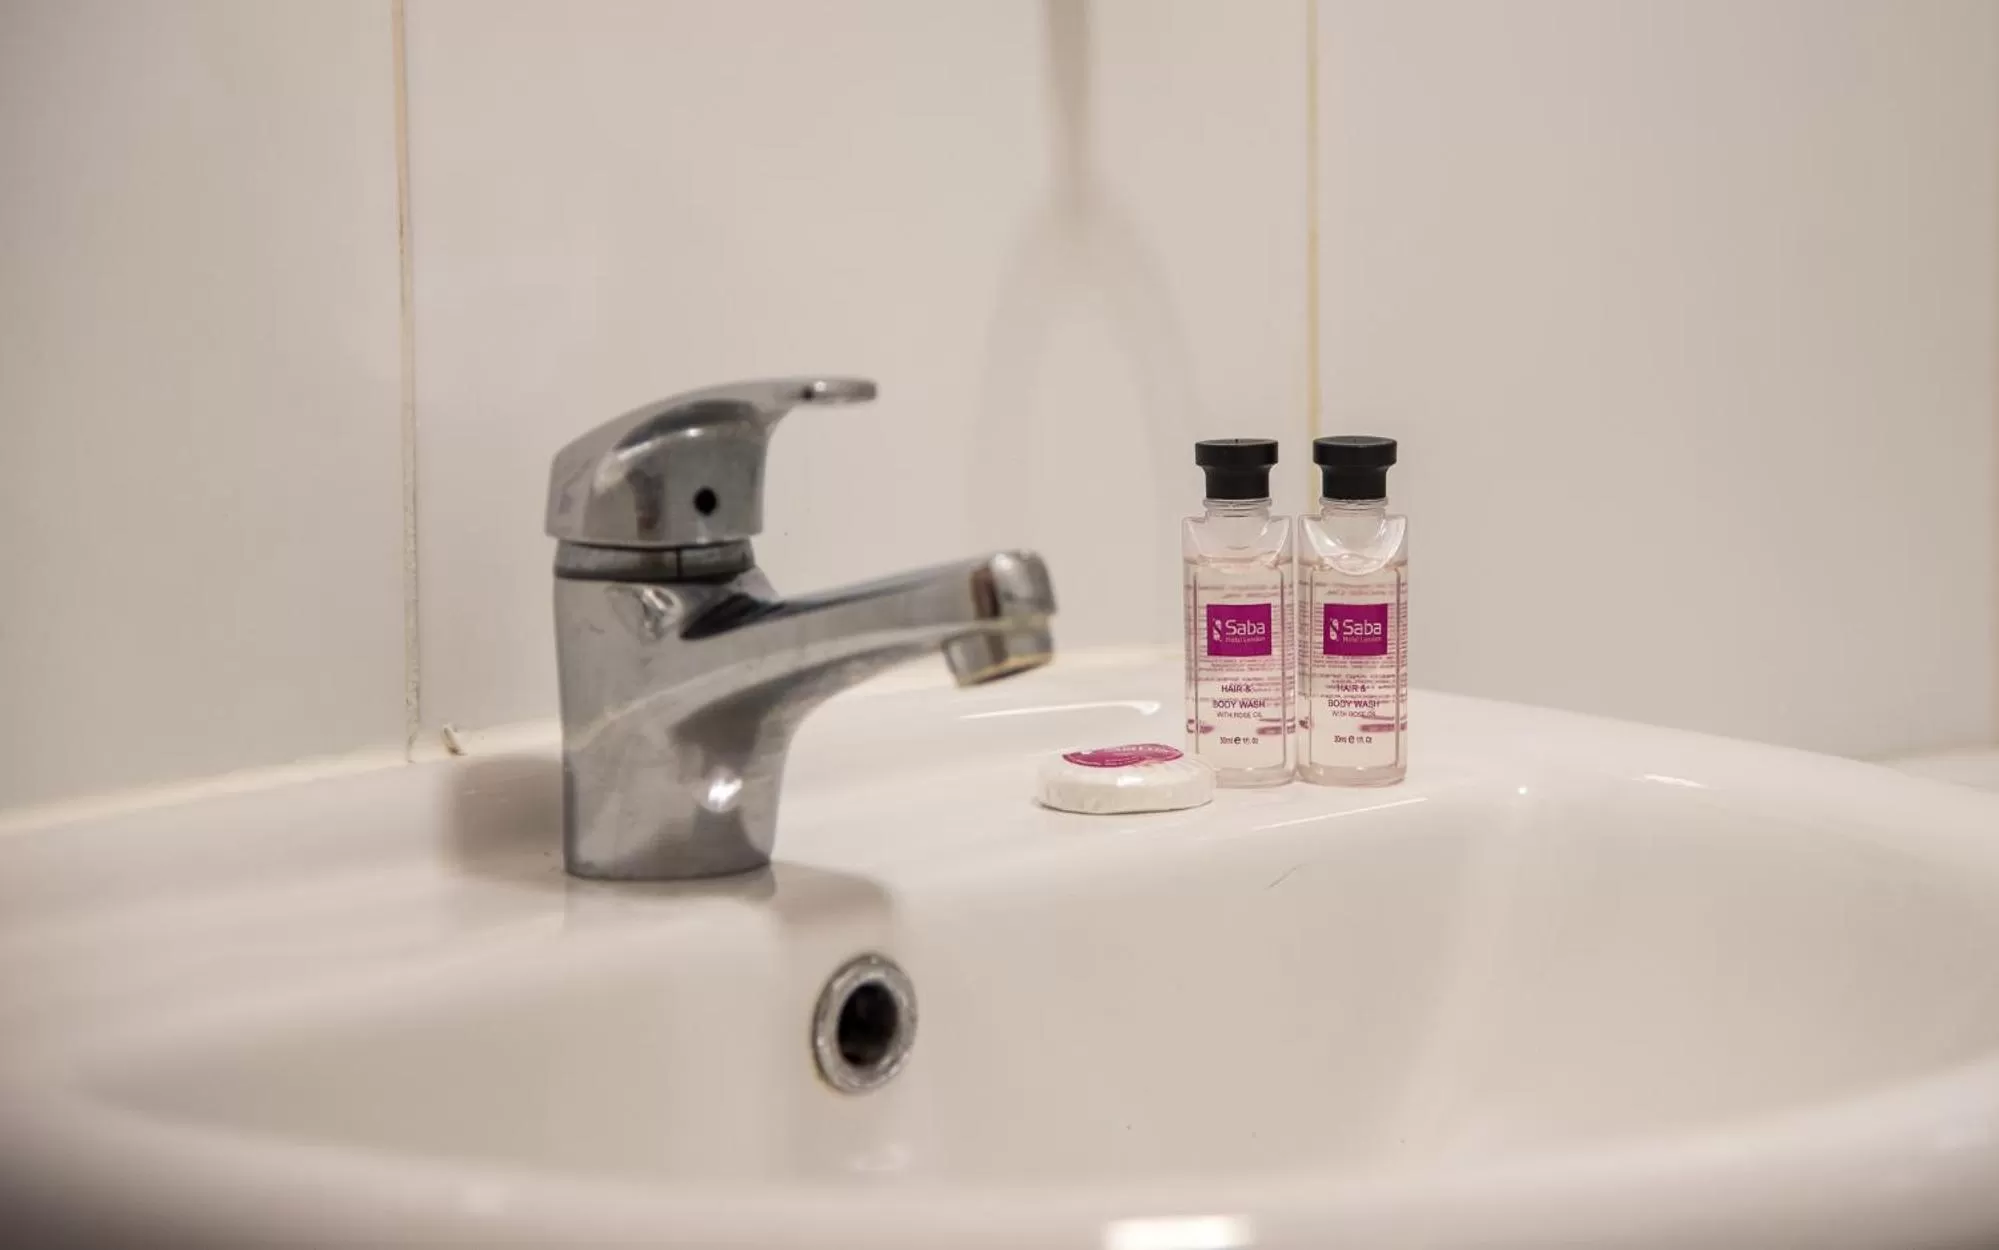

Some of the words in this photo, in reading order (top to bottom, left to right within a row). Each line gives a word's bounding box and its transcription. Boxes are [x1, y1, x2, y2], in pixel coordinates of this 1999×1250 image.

[1224, 619, 1266, 635] Saba
[1342, 618, 1382, 635] Saba
[1221, 684, 1243, 693] HAIR
[1337, 684, 1359, 693] HAIR
[1213, 699, 1237, 709] BODY
[1239, 699, 1266, 709] WASH
[1328, 699, 1351, 708] BODY
[1353, 699, 1380, 709] WASH
[1233, 711, 1251, 719] ROSE
[1332, 710, 1348, 718] WITH
[1348, 710, 1365, 718] ROSE
